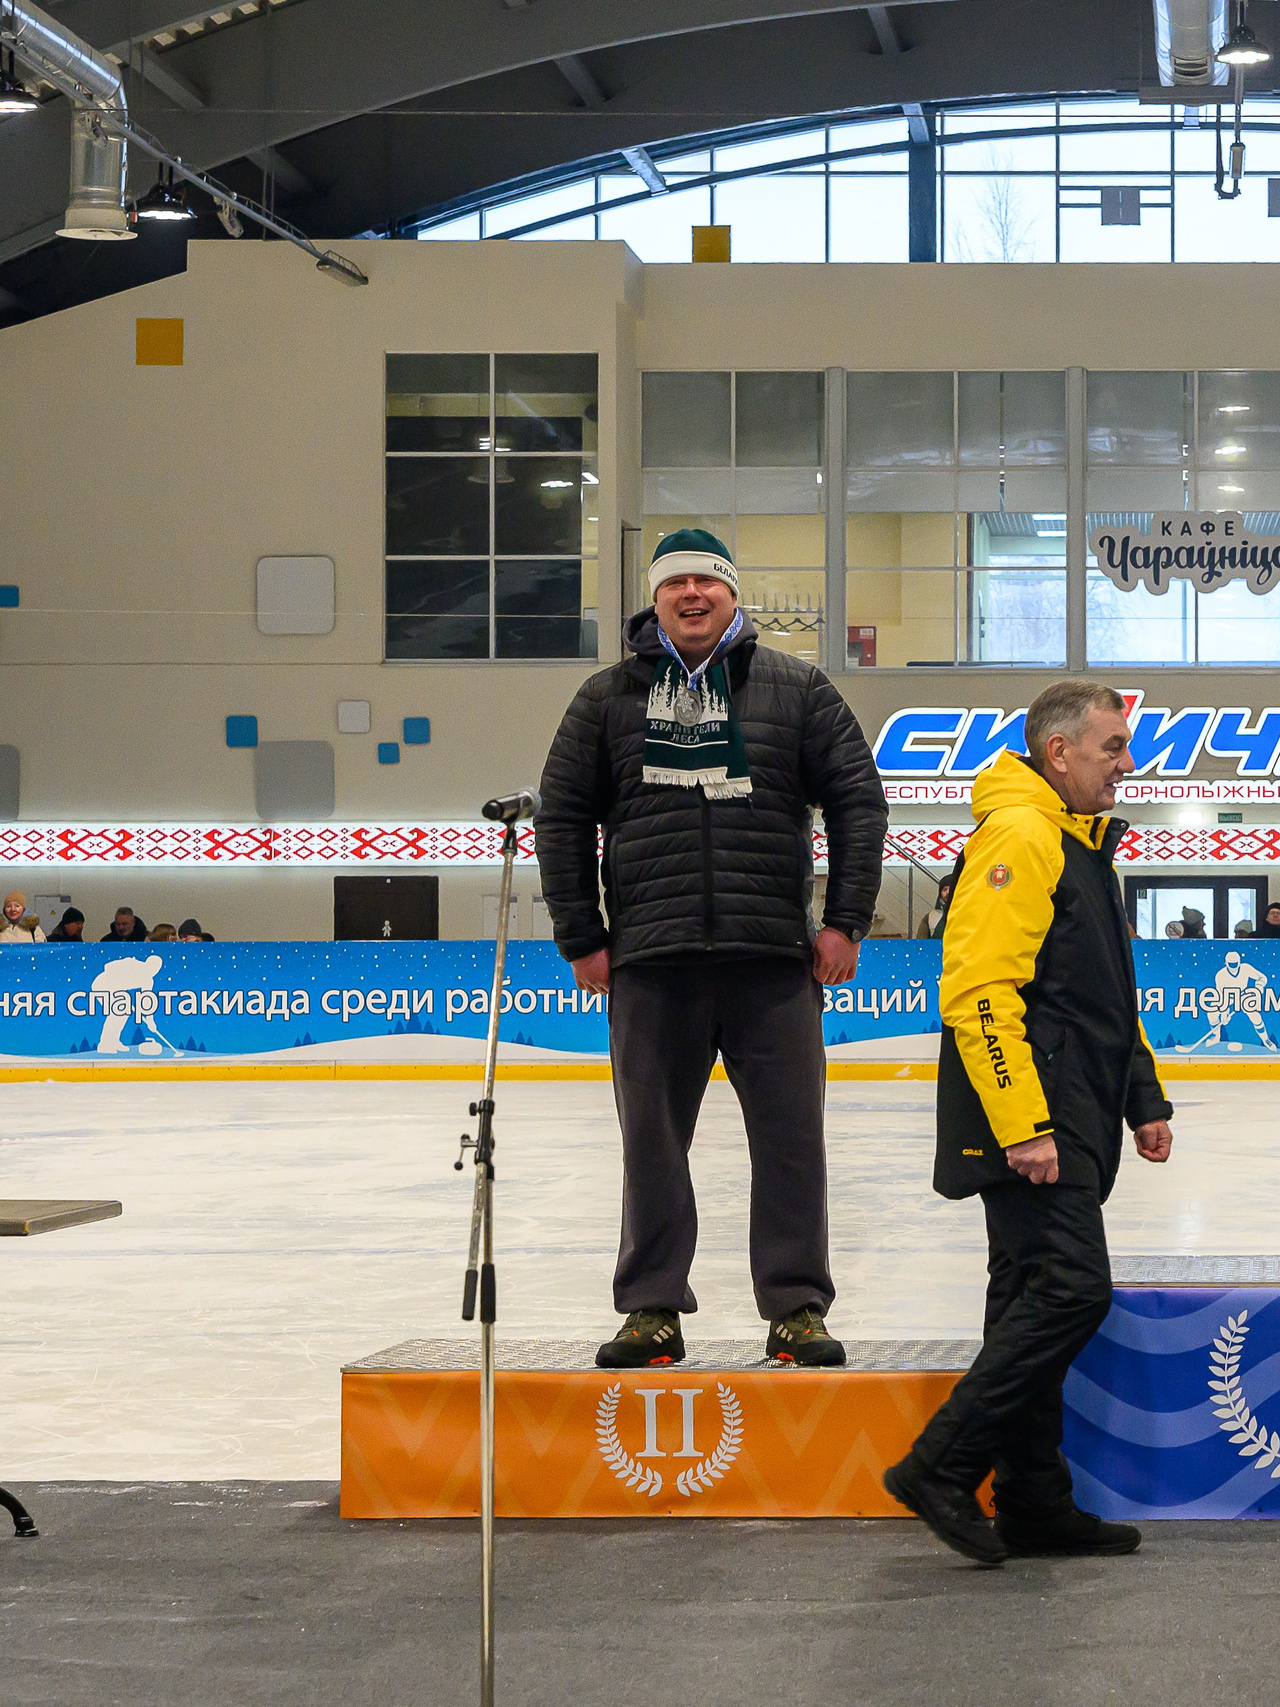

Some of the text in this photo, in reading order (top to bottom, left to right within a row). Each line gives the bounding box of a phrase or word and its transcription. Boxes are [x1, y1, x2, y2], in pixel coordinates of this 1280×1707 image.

[1161, 520, 1235, 536] КАФЕ
[670, 733, 700, 743] ЛЕСА
[66, 989, 310, 1024] спартакиада
[321, 987, 434, 1023] среди
[445, 978, 610, 1022] работни
[977, 998, 1012, 1090] BELARUS
[634, 1388, 704, 1457] II
